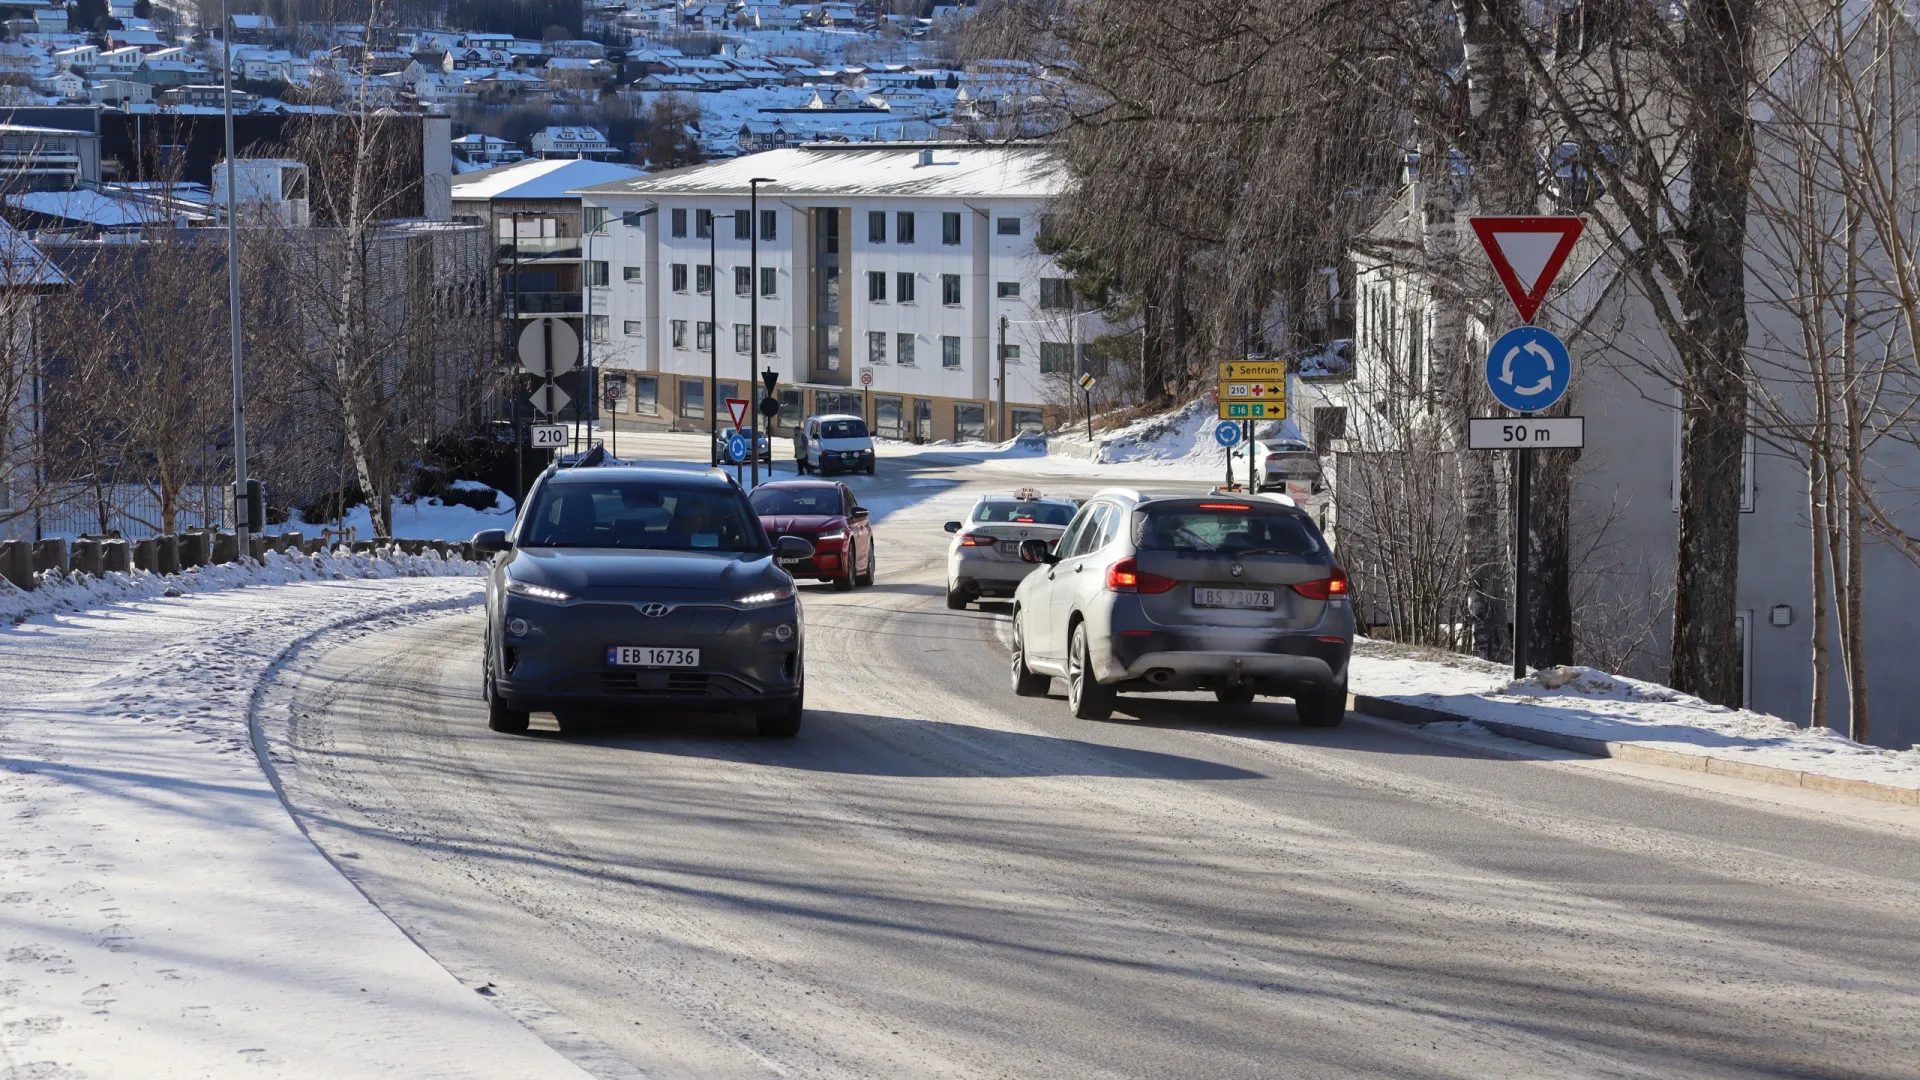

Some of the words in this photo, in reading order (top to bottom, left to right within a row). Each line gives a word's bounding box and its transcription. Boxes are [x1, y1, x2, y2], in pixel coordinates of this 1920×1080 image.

[1240, 366, 1279, 375] Sentrum
[1231, 386, 1246, 395] 210
[1255, 406, 1261, 414] 2
[538, 430, 562, 443] 210
[1503, 425, 1527, 442] 50
[1534, 428, 1550, 441] m
[1206, 590, 1223, 604] BS
[622, 648, 641, 664] EB
[648, 649, 694, 665] 16736
